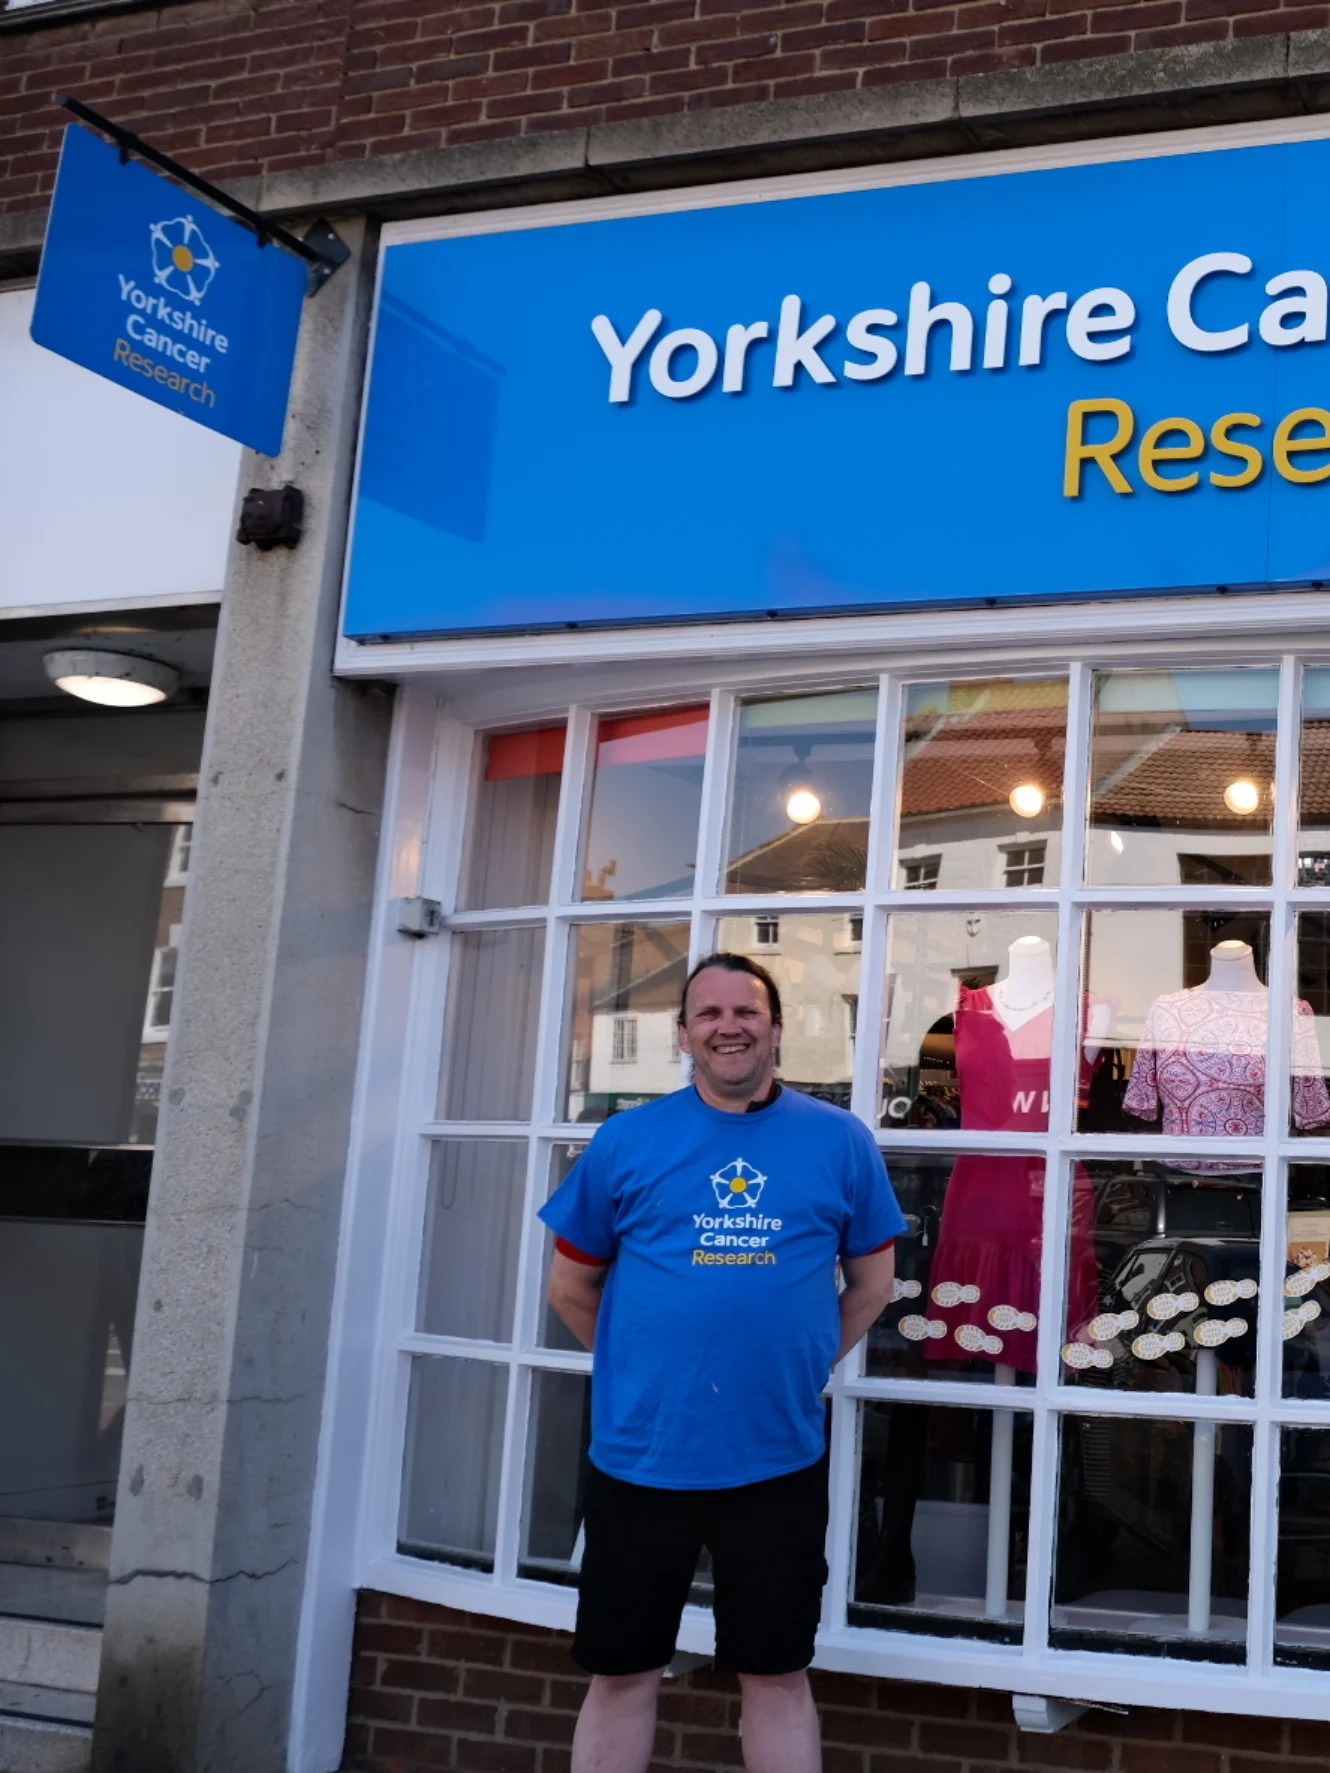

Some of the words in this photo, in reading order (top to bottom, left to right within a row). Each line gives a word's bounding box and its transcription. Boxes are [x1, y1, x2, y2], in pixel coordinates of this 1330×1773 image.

[118, 273, 229, 354] Yorkshire
[126, 313, 211, 373] Cancer
[591, 273, 1136, 403] Yorkshire
[113, 338, 216, 408] Research
[692, 1213, 782, 1231] Yorkshire
[699, 1232, 770, 1248] Cancer
[691, 1249, 776, 1266] Research
